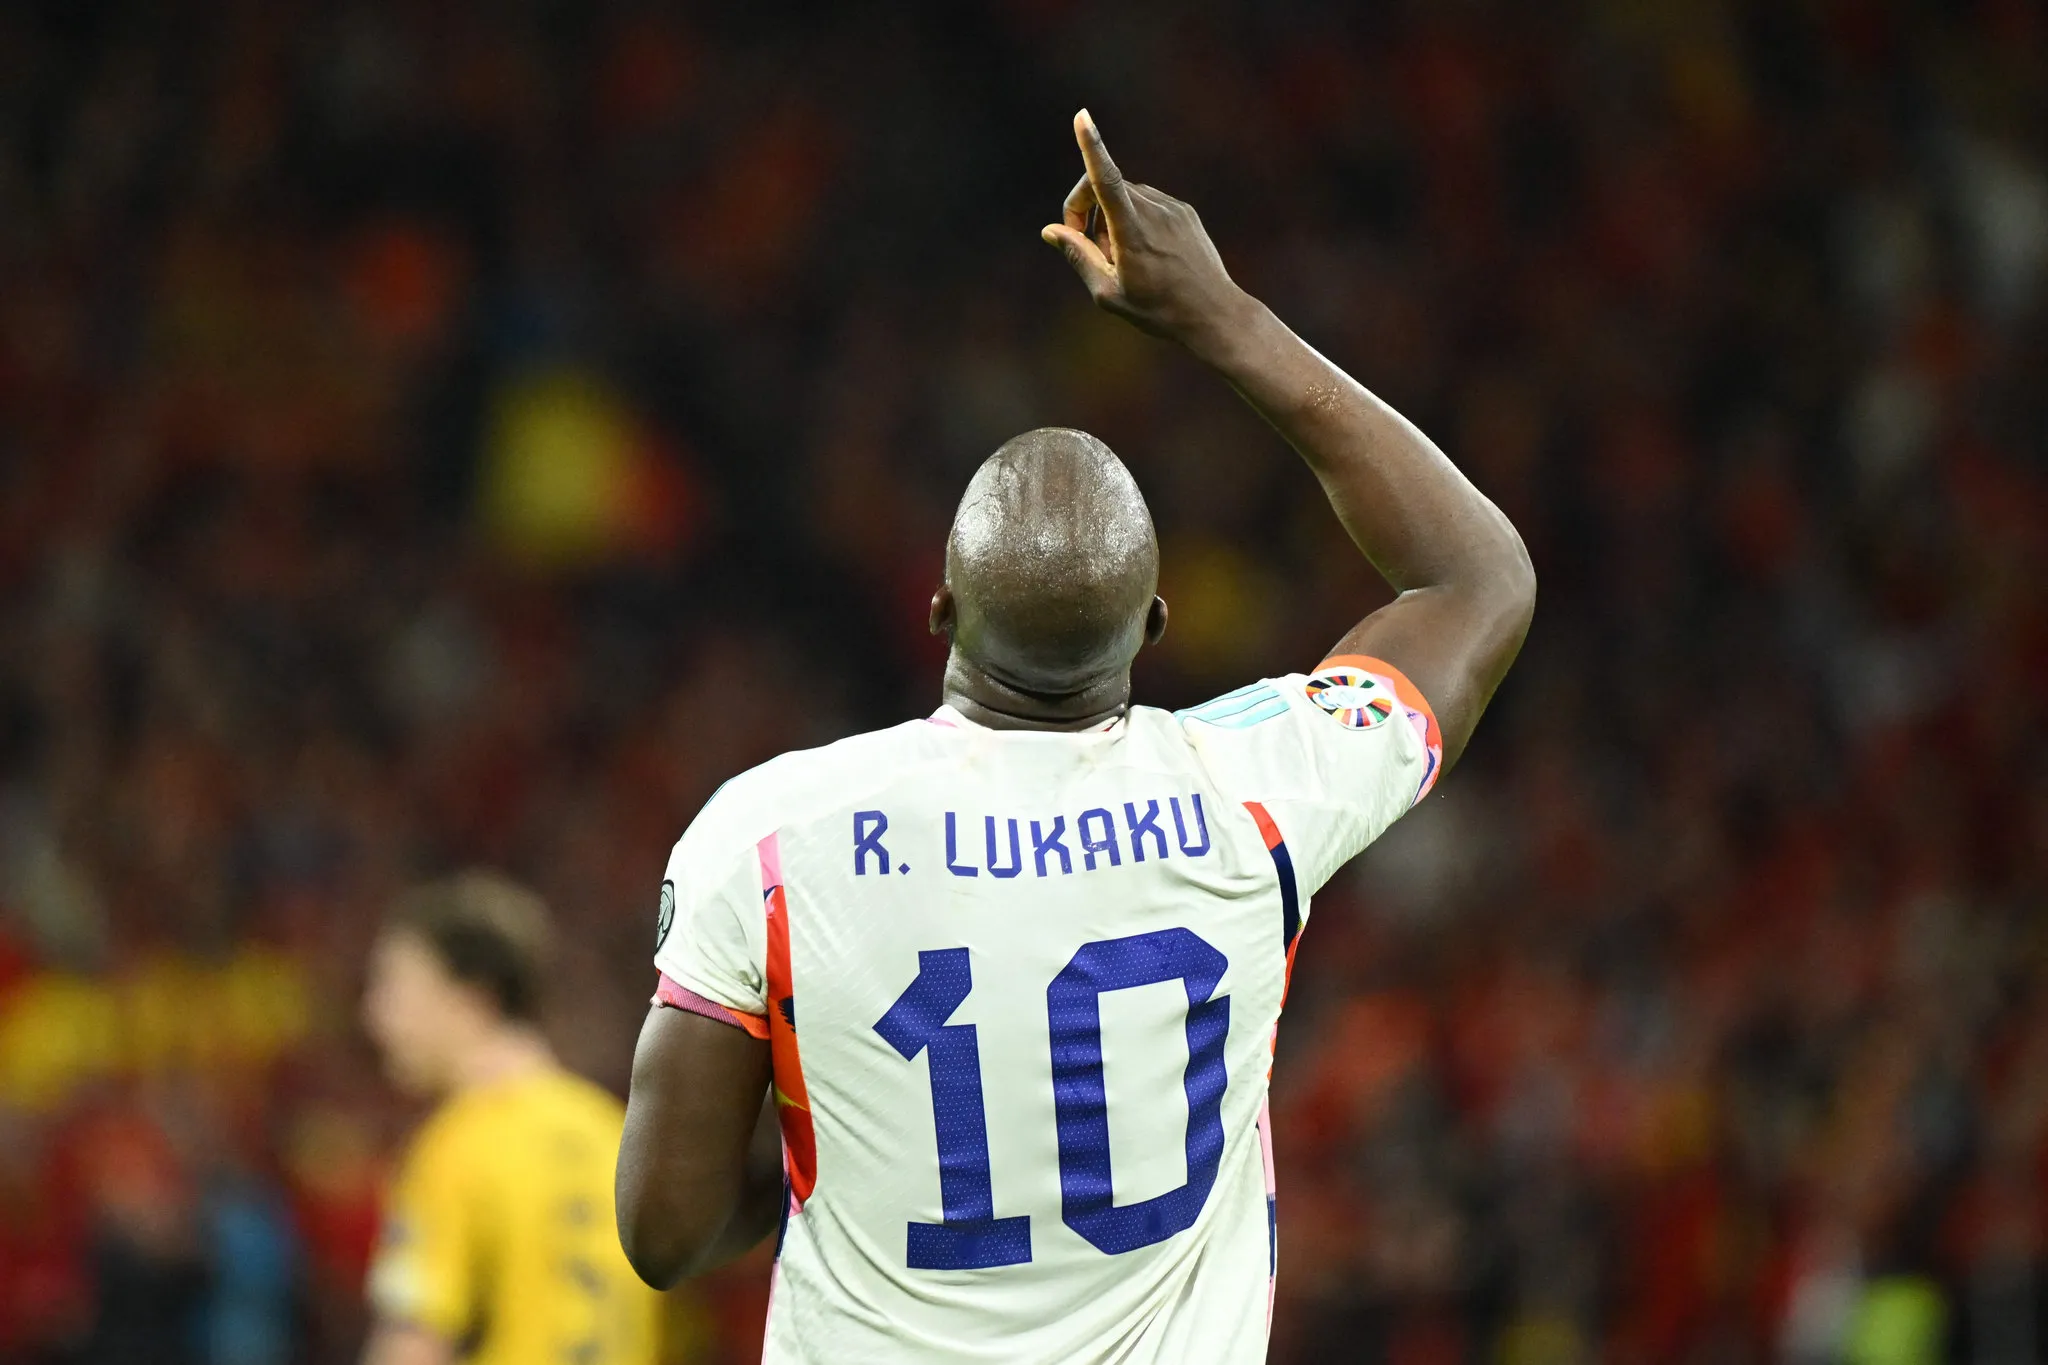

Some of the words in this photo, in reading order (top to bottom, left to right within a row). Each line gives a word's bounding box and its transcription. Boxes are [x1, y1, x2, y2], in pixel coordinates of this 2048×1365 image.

[853, 811, 911, 876] R.
[945, 793, 1211, 879] LUKAKU
[873, 927, 1231, 1271] 10
